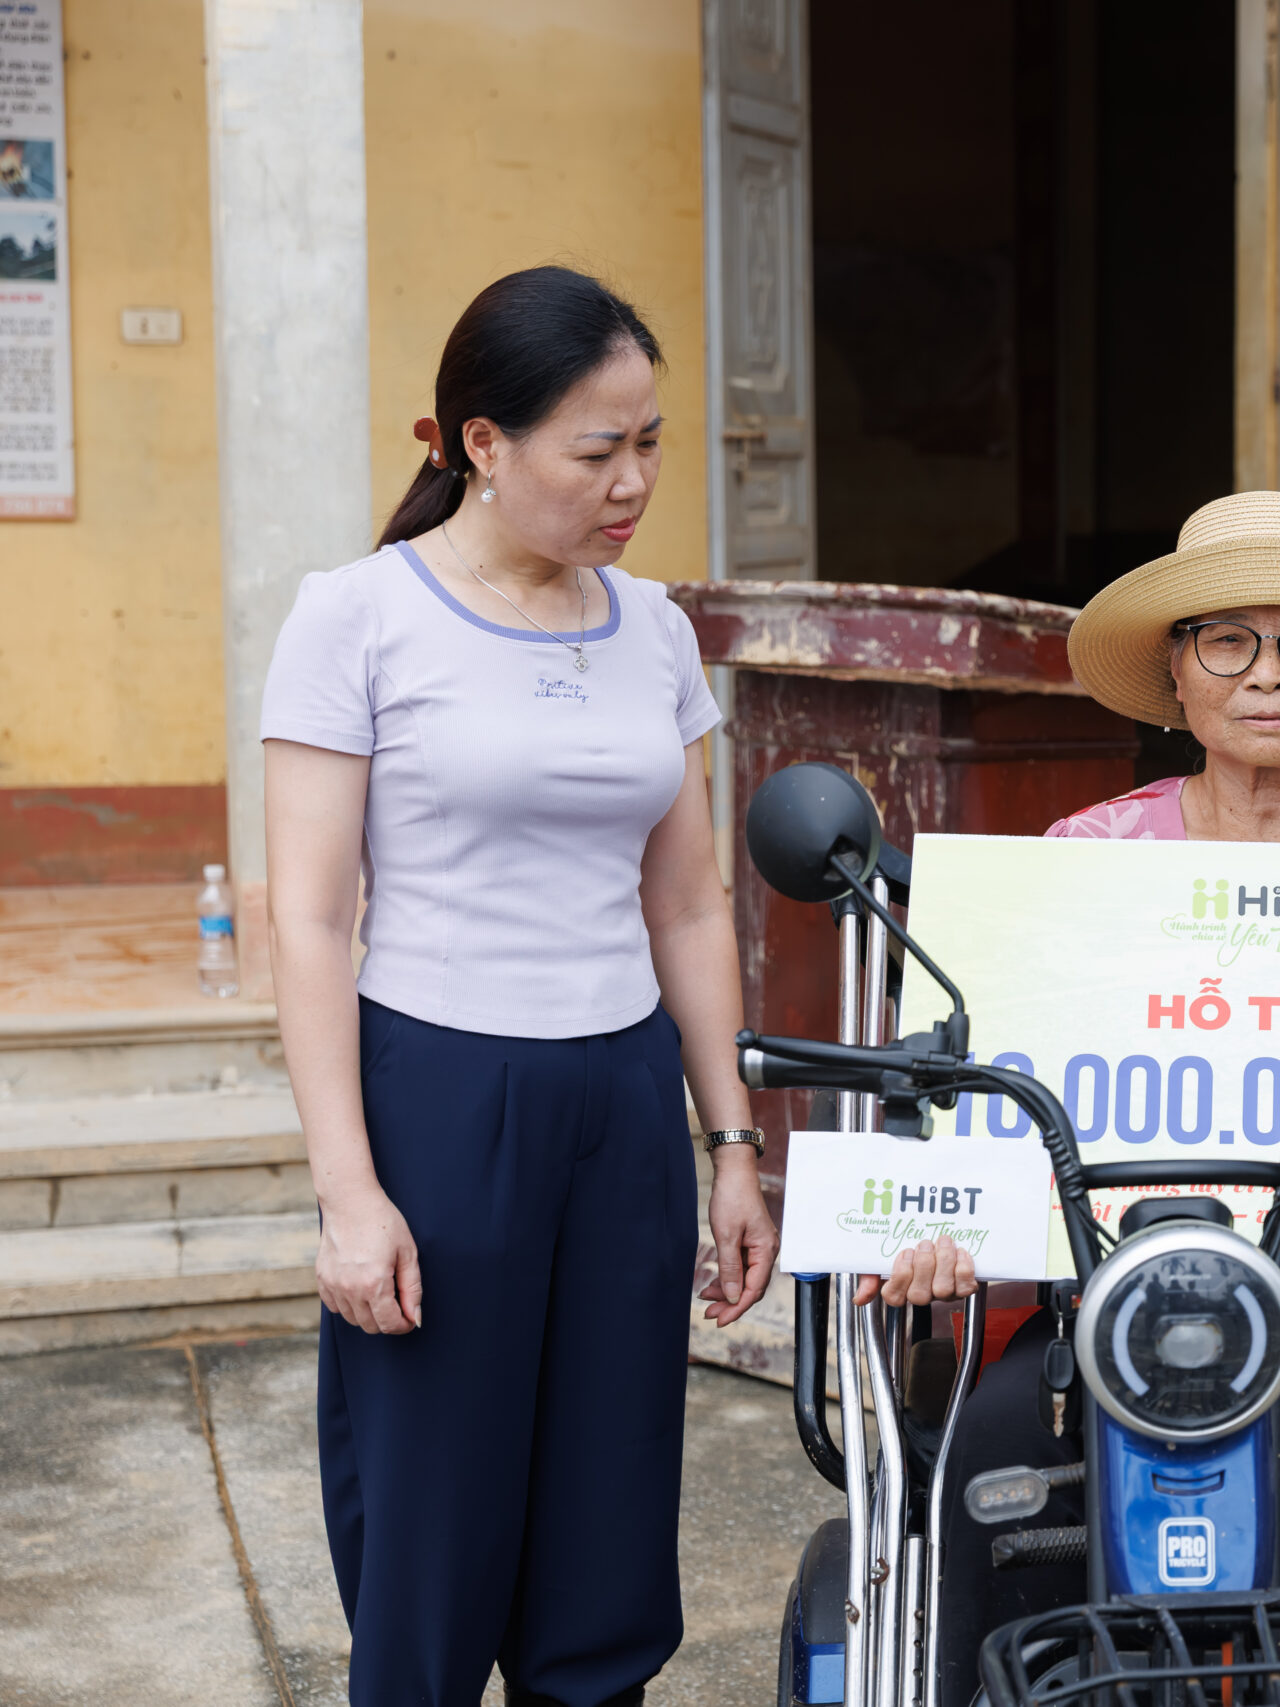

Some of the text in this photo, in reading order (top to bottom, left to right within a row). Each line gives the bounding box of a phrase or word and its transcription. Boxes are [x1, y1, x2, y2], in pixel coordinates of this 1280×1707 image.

[1217, 922, 1270, 968] Yêu
[1147, 977, 1231, 1031] HỖ
[900, 1184, 983, 1215] HiBT
[881, 1218, 925, 1258] Yêu
[1167, 1535, 1206, 1558] PRO
[1168, 1557, 1207, 1568] TRICYCLE
